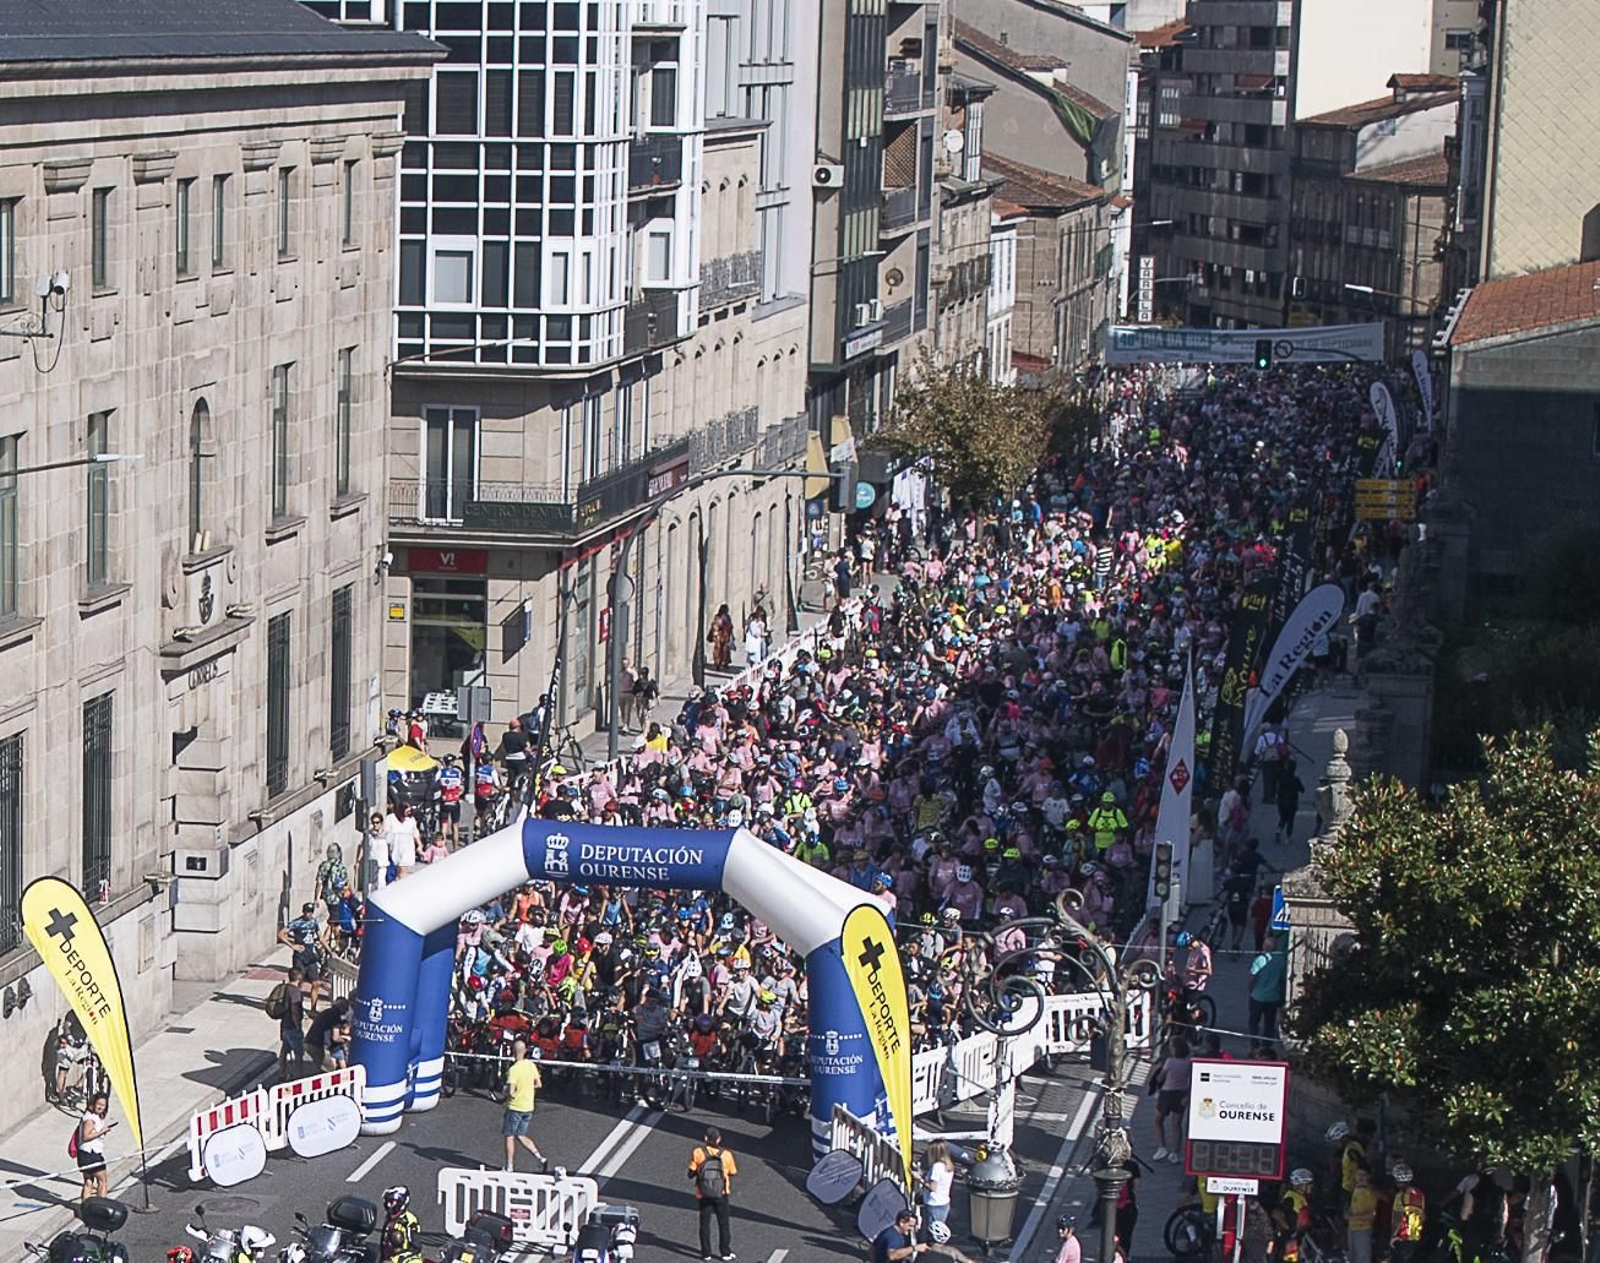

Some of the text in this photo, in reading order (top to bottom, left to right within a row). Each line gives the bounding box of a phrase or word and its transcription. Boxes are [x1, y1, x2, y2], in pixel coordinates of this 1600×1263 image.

[1141, 258, 1150, 320] VARELA
[464, 503, 516, 519] CENTRO
[521, 505, 570, 520] DENTAL
[1259, 673, 1283, 698] La
[580, 843, 704, 865] DEPUTACIÓN
[580, 862, 671, 882] OURENSE
[59, 940, 111, 1019] DEPORTE
[867, 970, 901, 1055] DEPORTE
[1219, 1100, 1255, 1110] Concello
[1219, 1110, 1275, 1121] OURENSE
